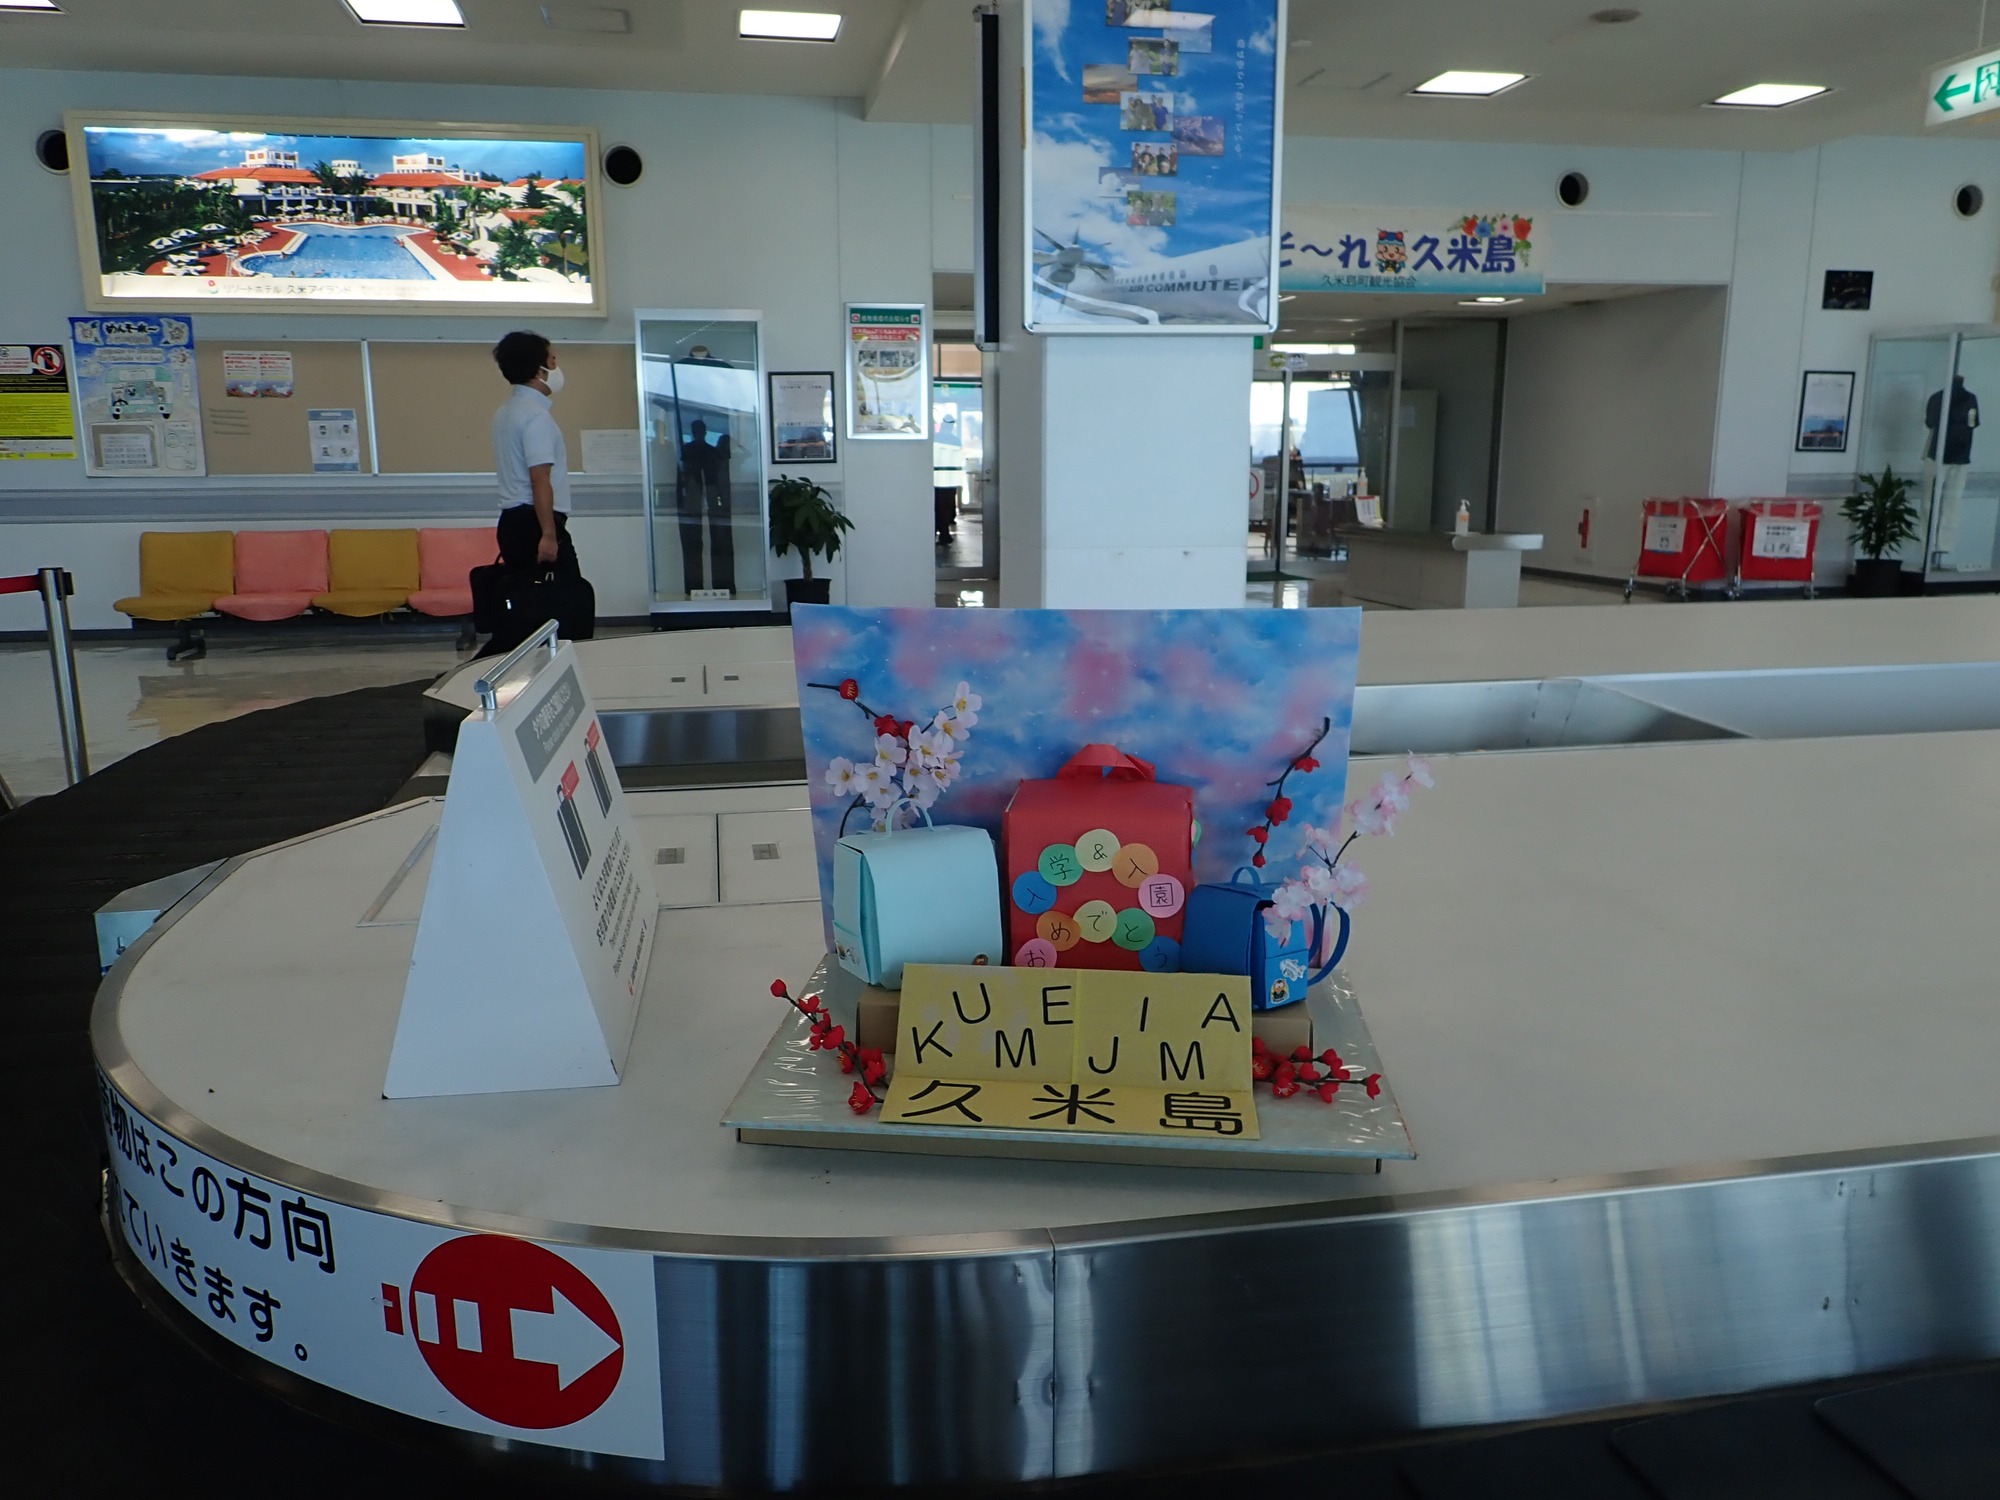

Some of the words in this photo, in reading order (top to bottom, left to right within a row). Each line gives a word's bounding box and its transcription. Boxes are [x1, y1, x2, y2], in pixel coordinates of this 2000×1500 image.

[1411, 234, 1515, 273] 久米島
[1320, 275, 1417, 289] 久米島町観光協会
[901, 1079, 1243, 1136] 久米島
